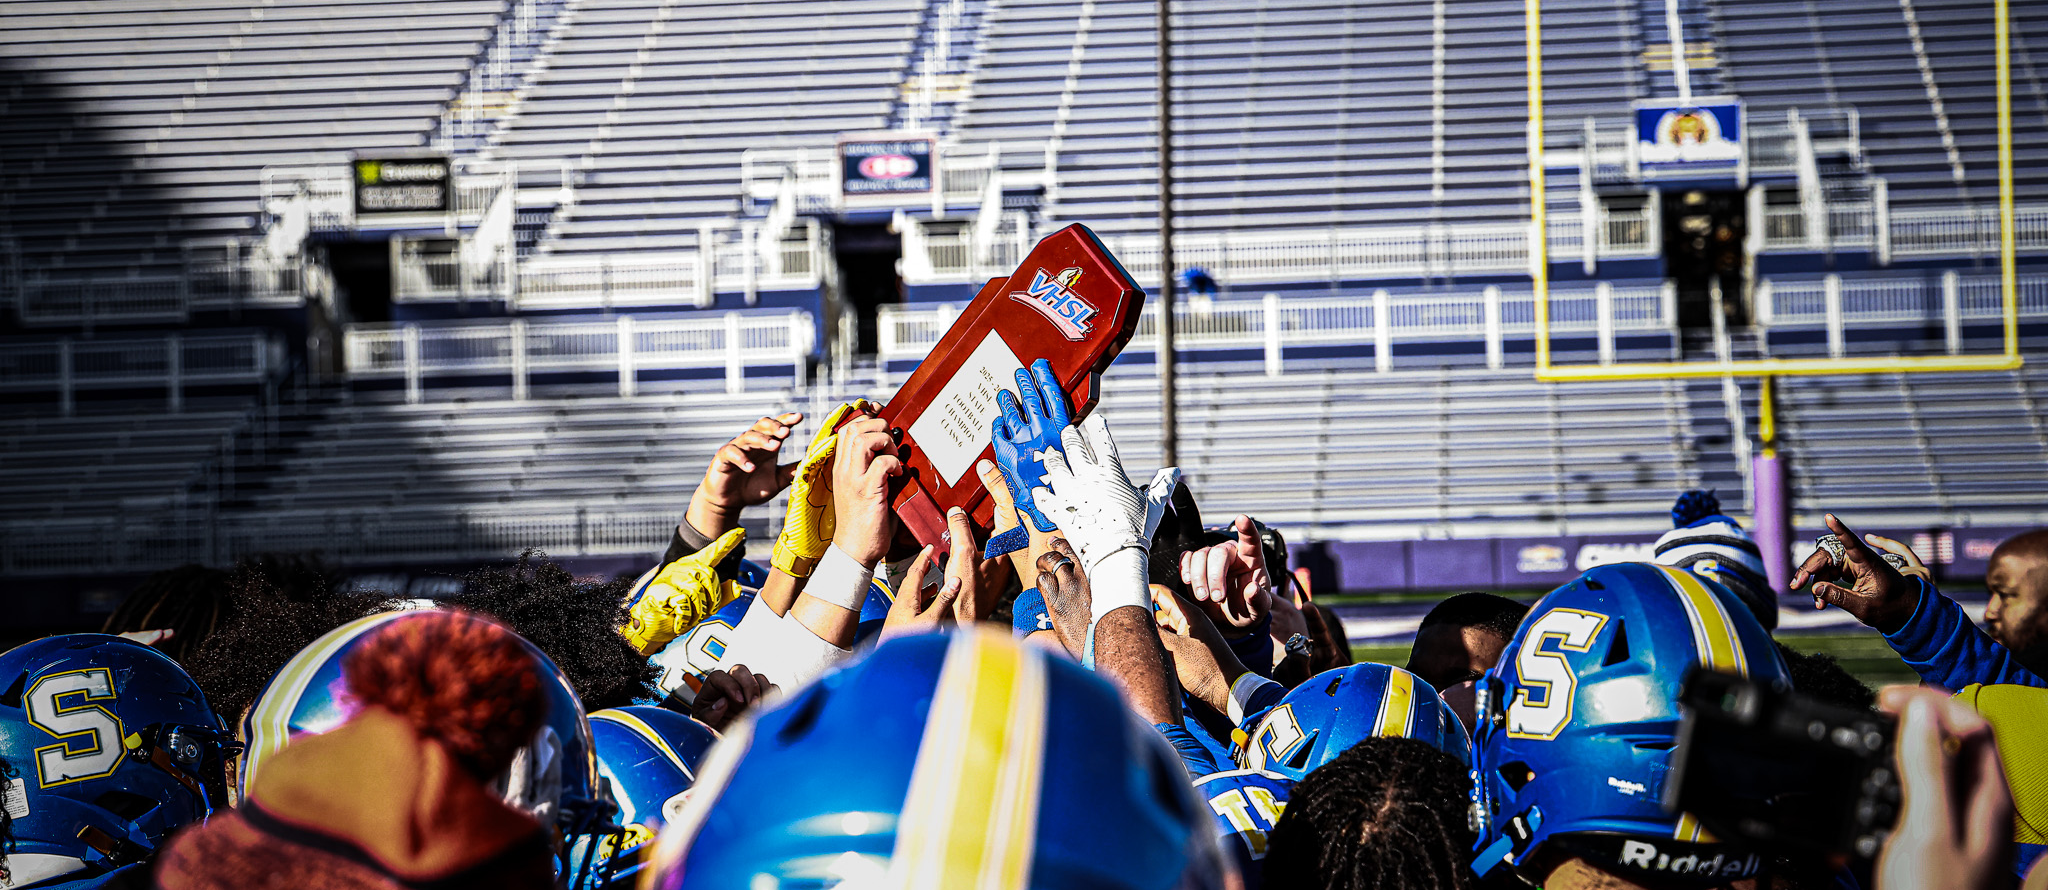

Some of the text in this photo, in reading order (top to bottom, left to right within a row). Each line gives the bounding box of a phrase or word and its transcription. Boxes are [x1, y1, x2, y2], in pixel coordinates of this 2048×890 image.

[1029, 273, 1092, 331] VHSL
[977, 382, 992, 405] VHSL
[979, 366, 993, 382] 2025
[953, 393, 983, 434] FOOTBALL
[969, 391, 985, 415] STATE
[940, 418, 959, 443] CLASS
[944, 403, 975, 443] CHAMPION
[1506, 607, 1609, 741] S
[23, 667, 128, 789] S
[1618, 839, 1761, 877] Riddell
